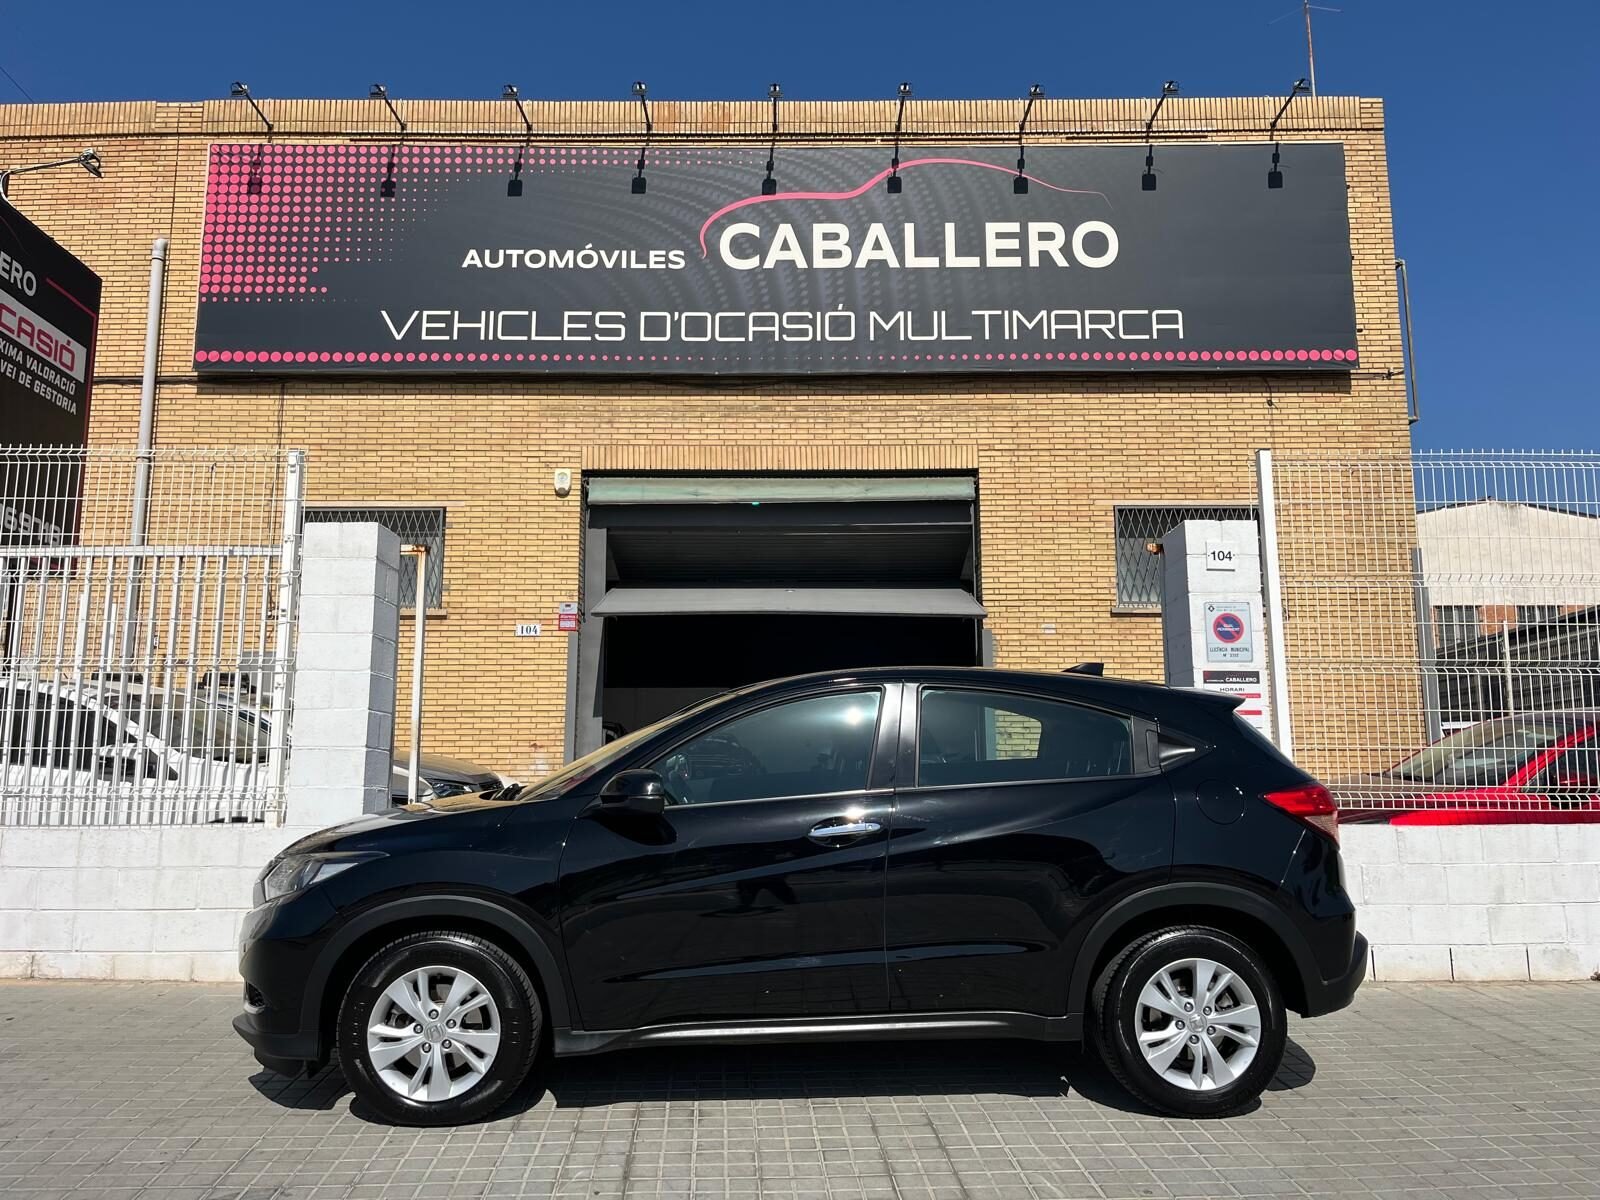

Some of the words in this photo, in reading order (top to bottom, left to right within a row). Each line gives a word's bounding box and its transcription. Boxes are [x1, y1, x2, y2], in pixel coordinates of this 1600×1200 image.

[461, 243, 686, 270] AUTOMÓVILES
[719, 220, 1119, 271] CABALLERO
[380, 309, 627, 342] VEHICLES
[639, 303, 856, 343] D'OCASIÓ
[869, 308, 1185, 342] MULTIMARCA
[18, 371, 32, 390] DE
[33, 381, 77, 416] GESTORIA
[26, 354, 77, 396] VALORACIÓ
[1210, 550, 1233, 562] 104
[520, 625, 538, 635] 104
